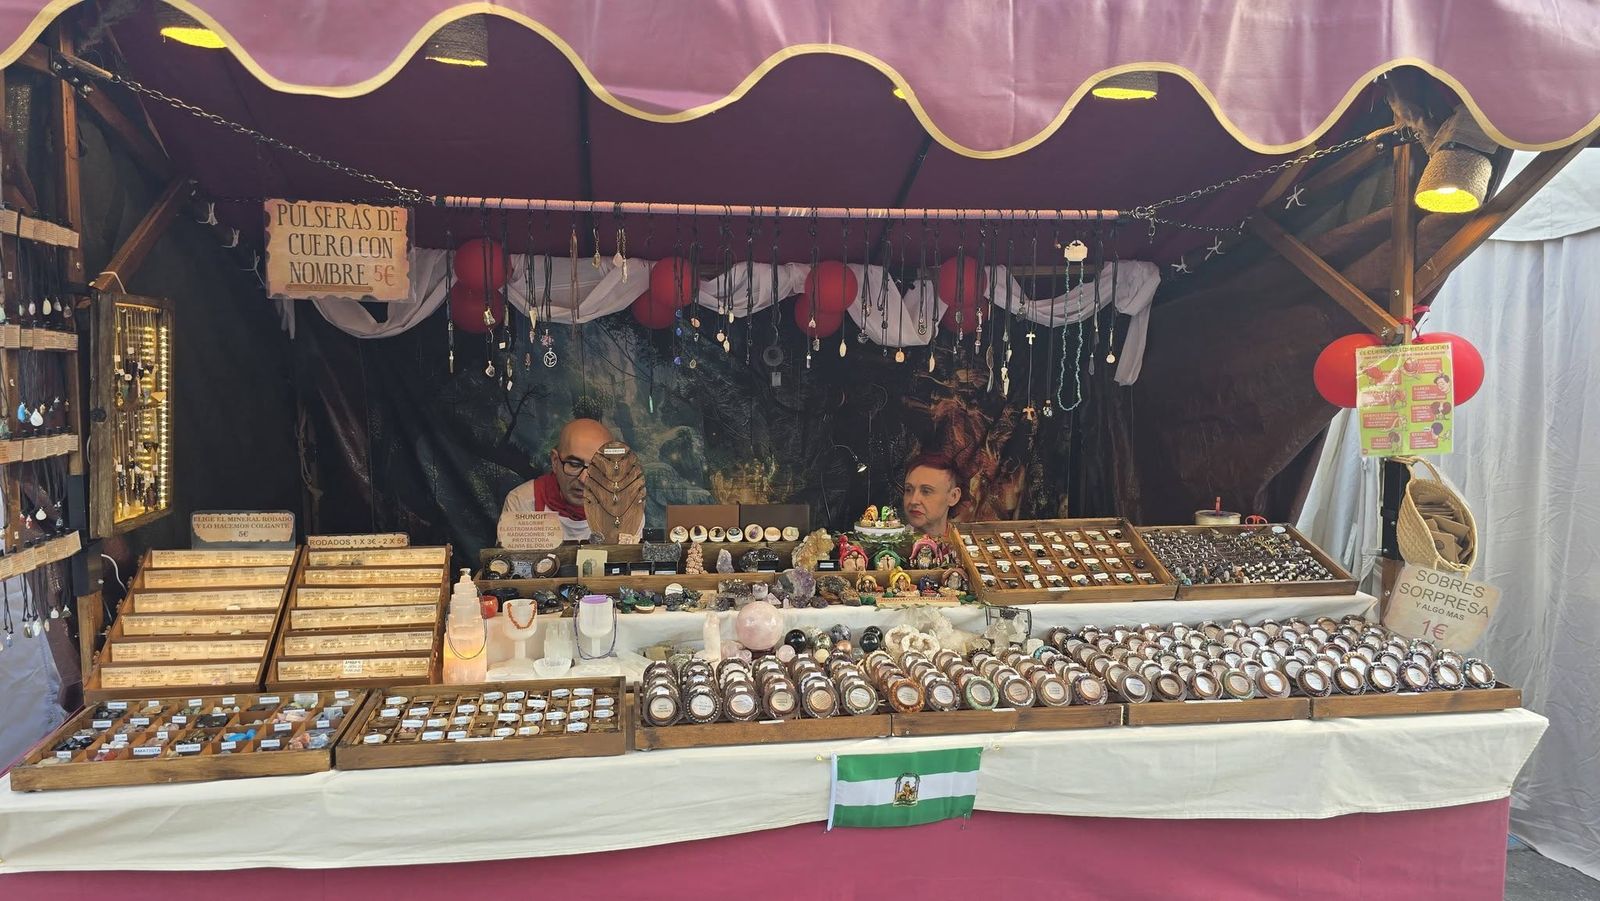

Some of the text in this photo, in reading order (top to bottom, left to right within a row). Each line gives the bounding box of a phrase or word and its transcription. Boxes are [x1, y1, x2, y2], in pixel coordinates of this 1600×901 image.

[277, 203, 402, 232] PULSERAS DE
[288, 233, 393, 259] CUERO CON
[290, 261, 395, 286] NOMBRE 5€
[1415, 569, 1485, 599] SOBRES
[1399, 582, 1489, 618] SORPRESA
[1421, 603, 1445, 615] ALGO
[1446, 610, 1465, 621] MAS
[1422, 619, 1449, 641] 1€
